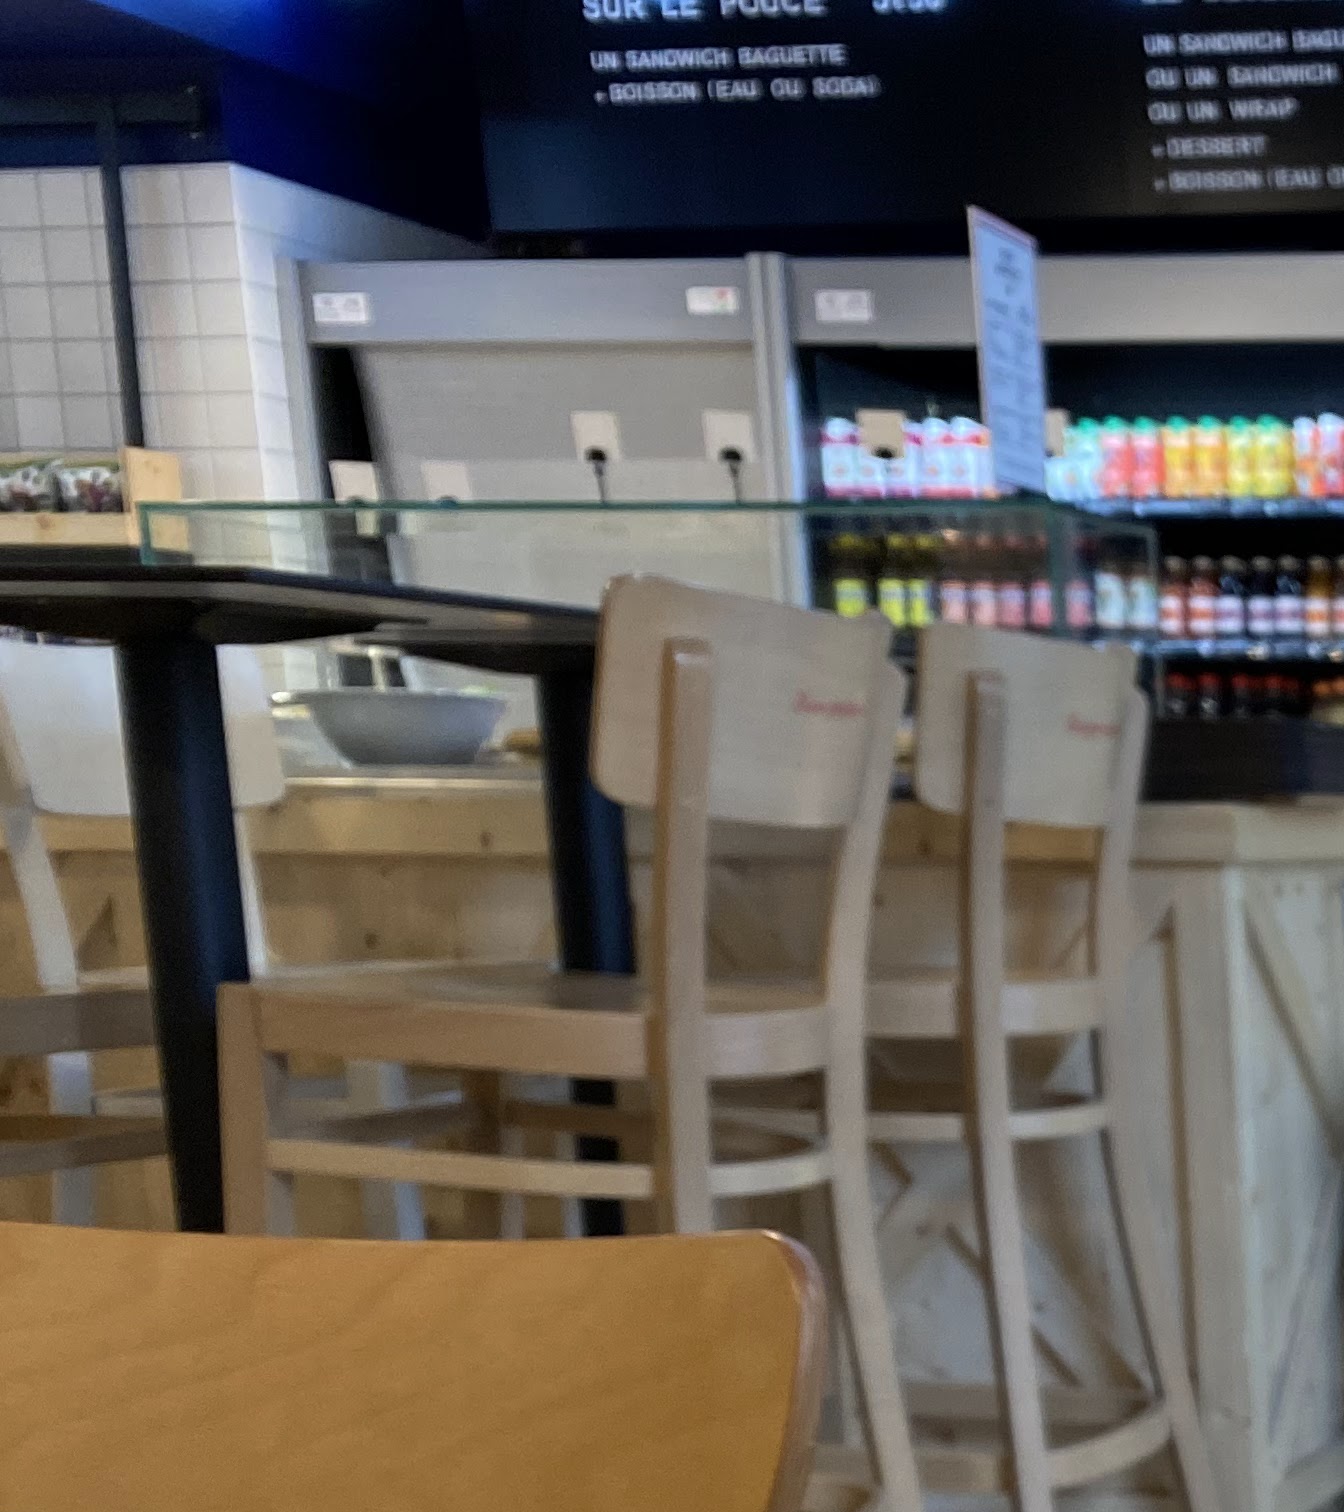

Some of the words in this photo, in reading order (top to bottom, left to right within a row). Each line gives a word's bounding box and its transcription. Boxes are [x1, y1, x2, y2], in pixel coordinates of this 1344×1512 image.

[1179, 30, 1288, 54] SANDWICH
[590, 50, 621, 71] UN
[625, 47, 733, 70] SANDWICH
[737, 43, 848, 68] BAGUETTE
[1227, 61, 1341, 87] SANDWICH
[770, 78, 806, 100] OU
